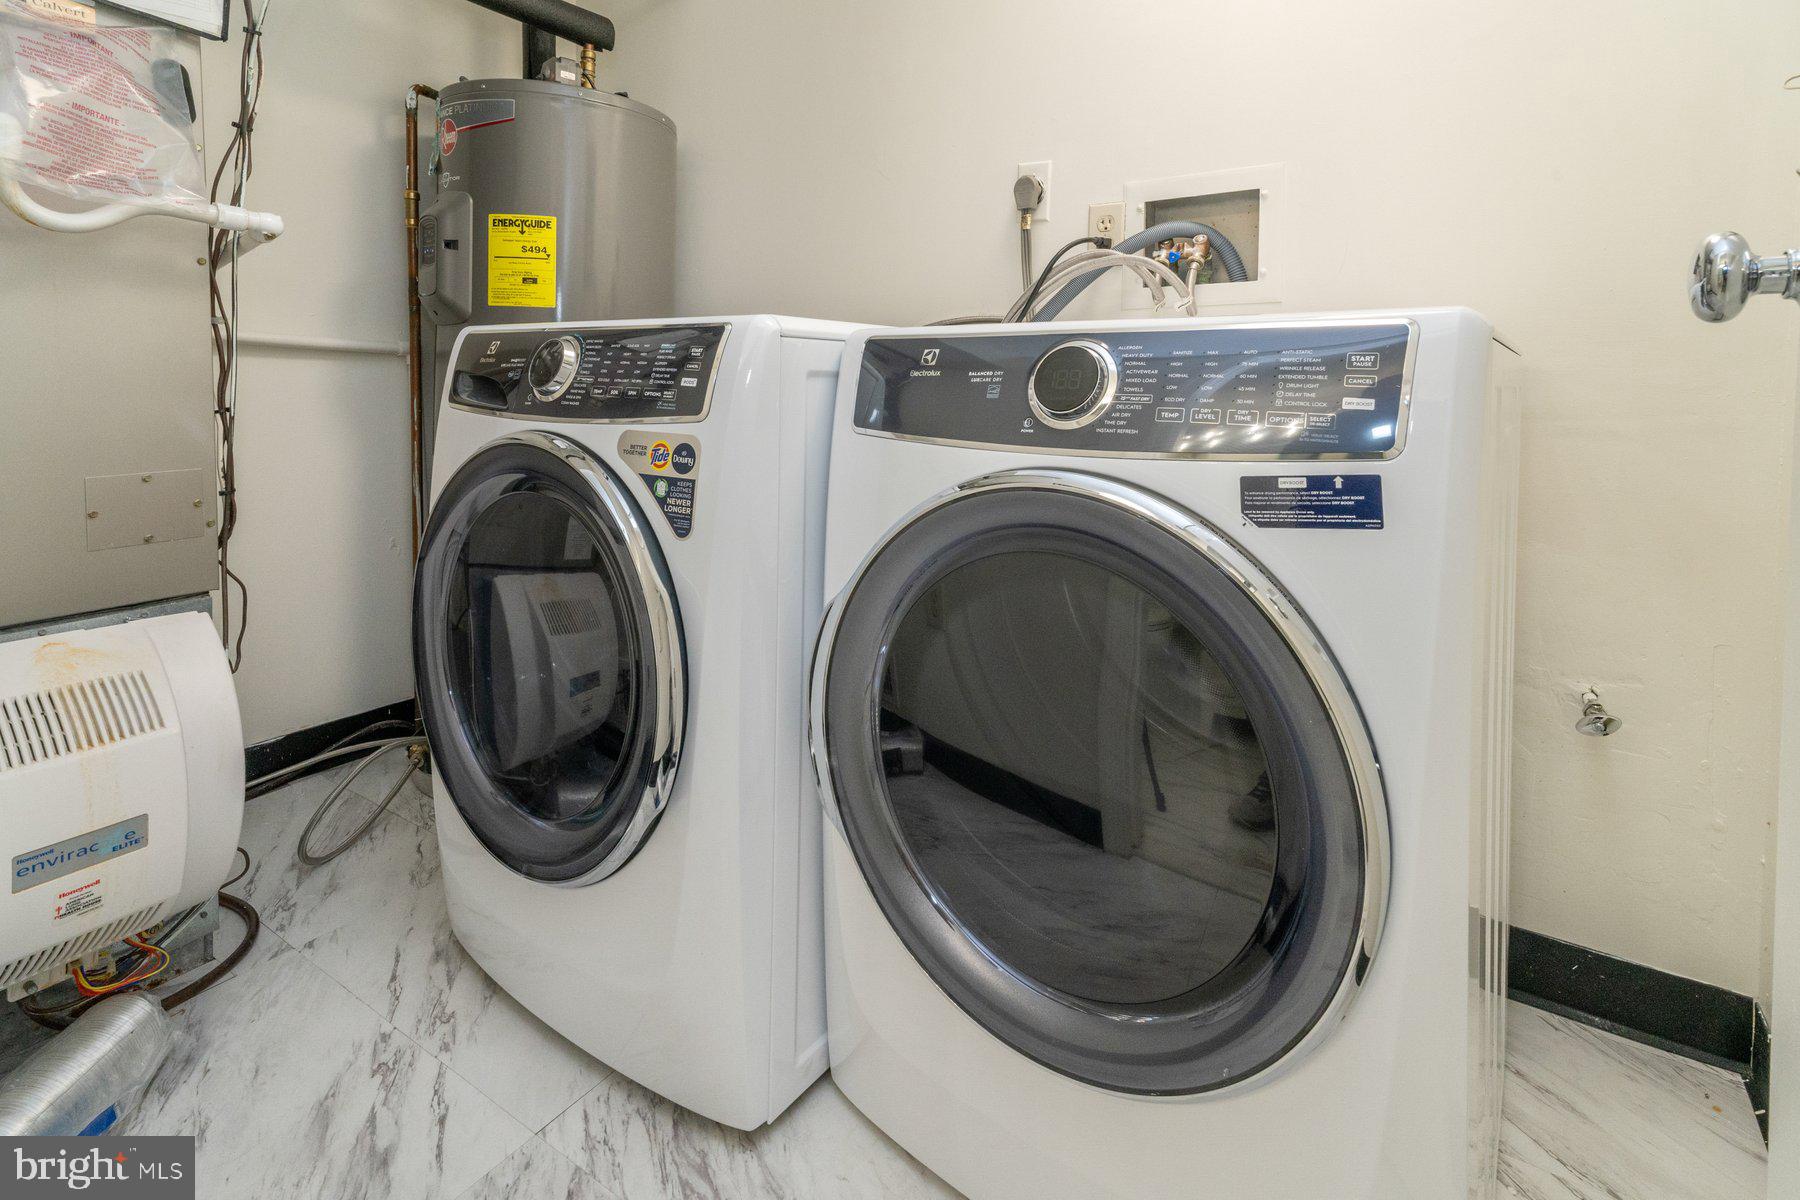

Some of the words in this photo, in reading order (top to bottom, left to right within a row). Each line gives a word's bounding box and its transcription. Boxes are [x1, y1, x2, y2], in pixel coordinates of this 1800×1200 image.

[71, 102, 120, 127] IMPORTANTE
[909, 369, 941, 377] Electrolux
[623, 449, 647, 457] TOGETHER
[650, 447, 670, 466] Tide
[673, 454, 694, 467] Downy
[677, 480, 693, 488] KEEPS
[670, 486, 693, 494] CLOTHES
[666, 497, 692, 507] NEWER
[664, 505, 692, 515] LONGER
[112, 838, 141, 852] ELITE
[16, 848, 55, 866] Honeywell
[58, 878, 101, 899] Honeywell
